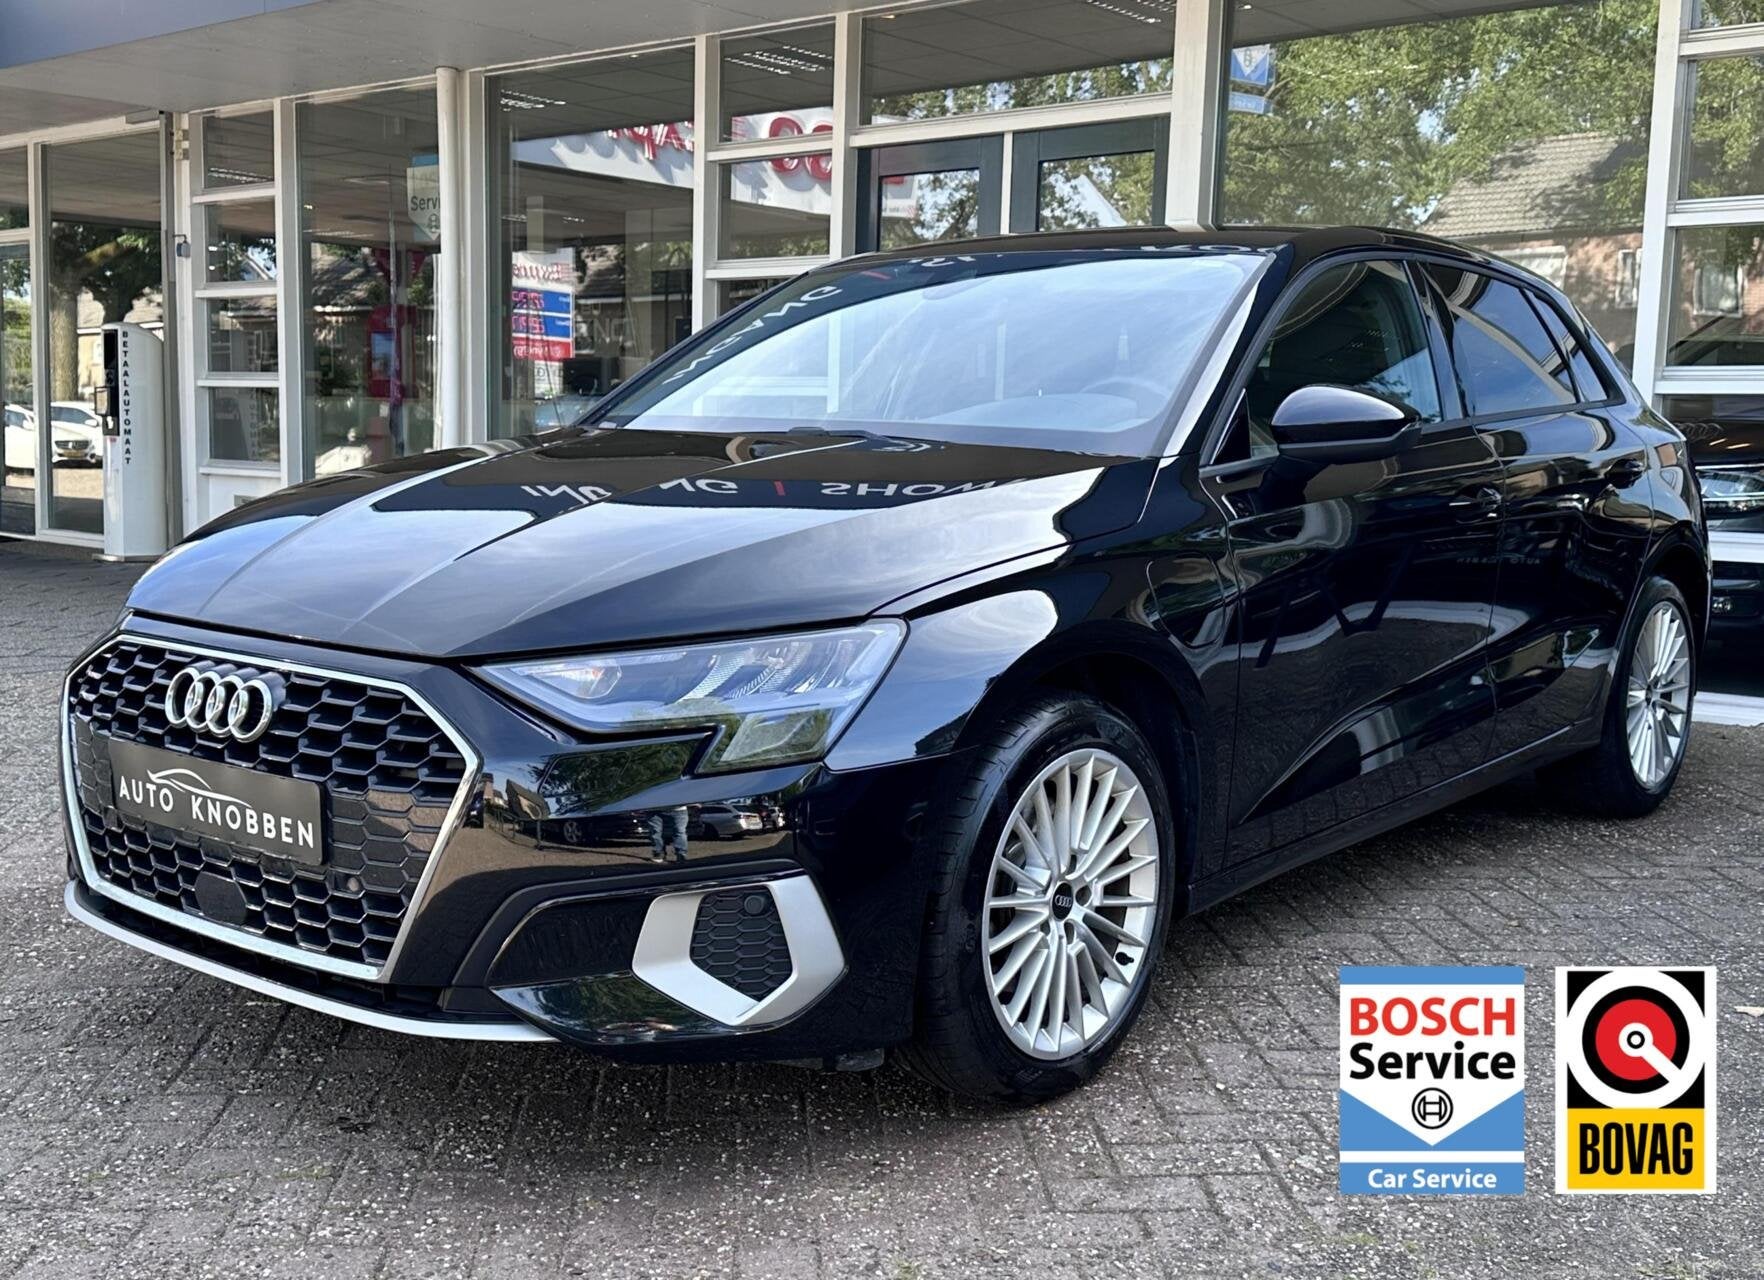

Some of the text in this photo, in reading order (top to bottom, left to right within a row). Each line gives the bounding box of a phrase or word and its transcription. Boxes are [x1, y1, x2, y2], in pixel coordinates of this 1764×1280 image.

[410, 192, 440, 211] Servi
[122, 330, 132, 465] BETAALAUTOMAAT
[119, 775, 315, 849] AUTO KNOBBEN
